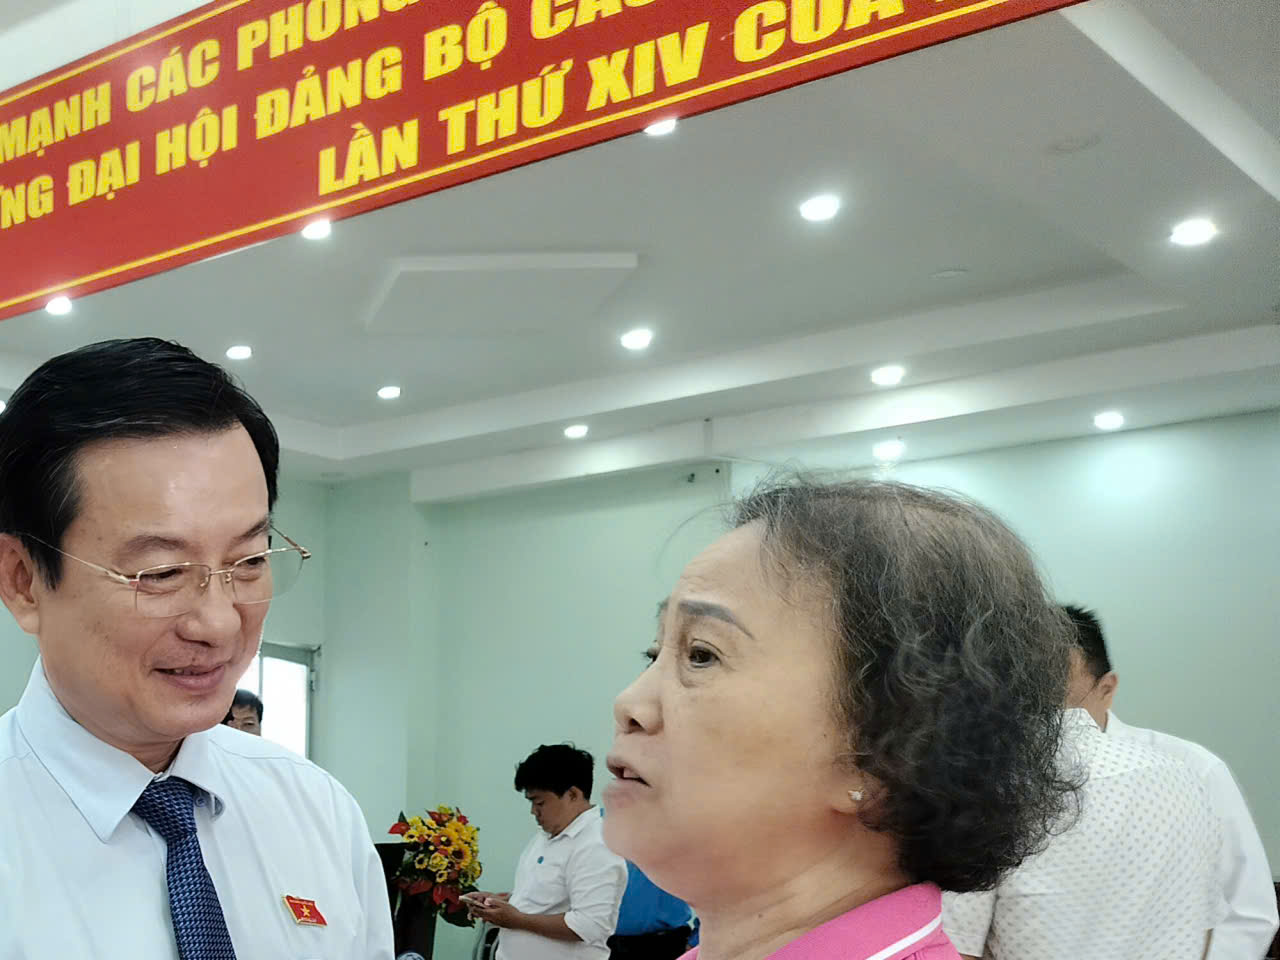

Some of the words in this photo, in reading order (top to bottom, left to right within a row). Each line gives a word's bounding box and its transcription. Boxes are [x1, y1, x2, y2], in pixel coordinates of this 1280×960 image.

[68, 140, 140, 206] ĐẠI
[155, 104, 238, 175] HỘI
[254, 46, 403, 140] ĐẢNG
[423, 1, 508, 81] BỘ
[125, 39, 221, 113] CÁC
[319, 119, 419, 197] LẦN
[438, 58, 574, 156] THỨ
[586, 22, 710, 112] XIV
